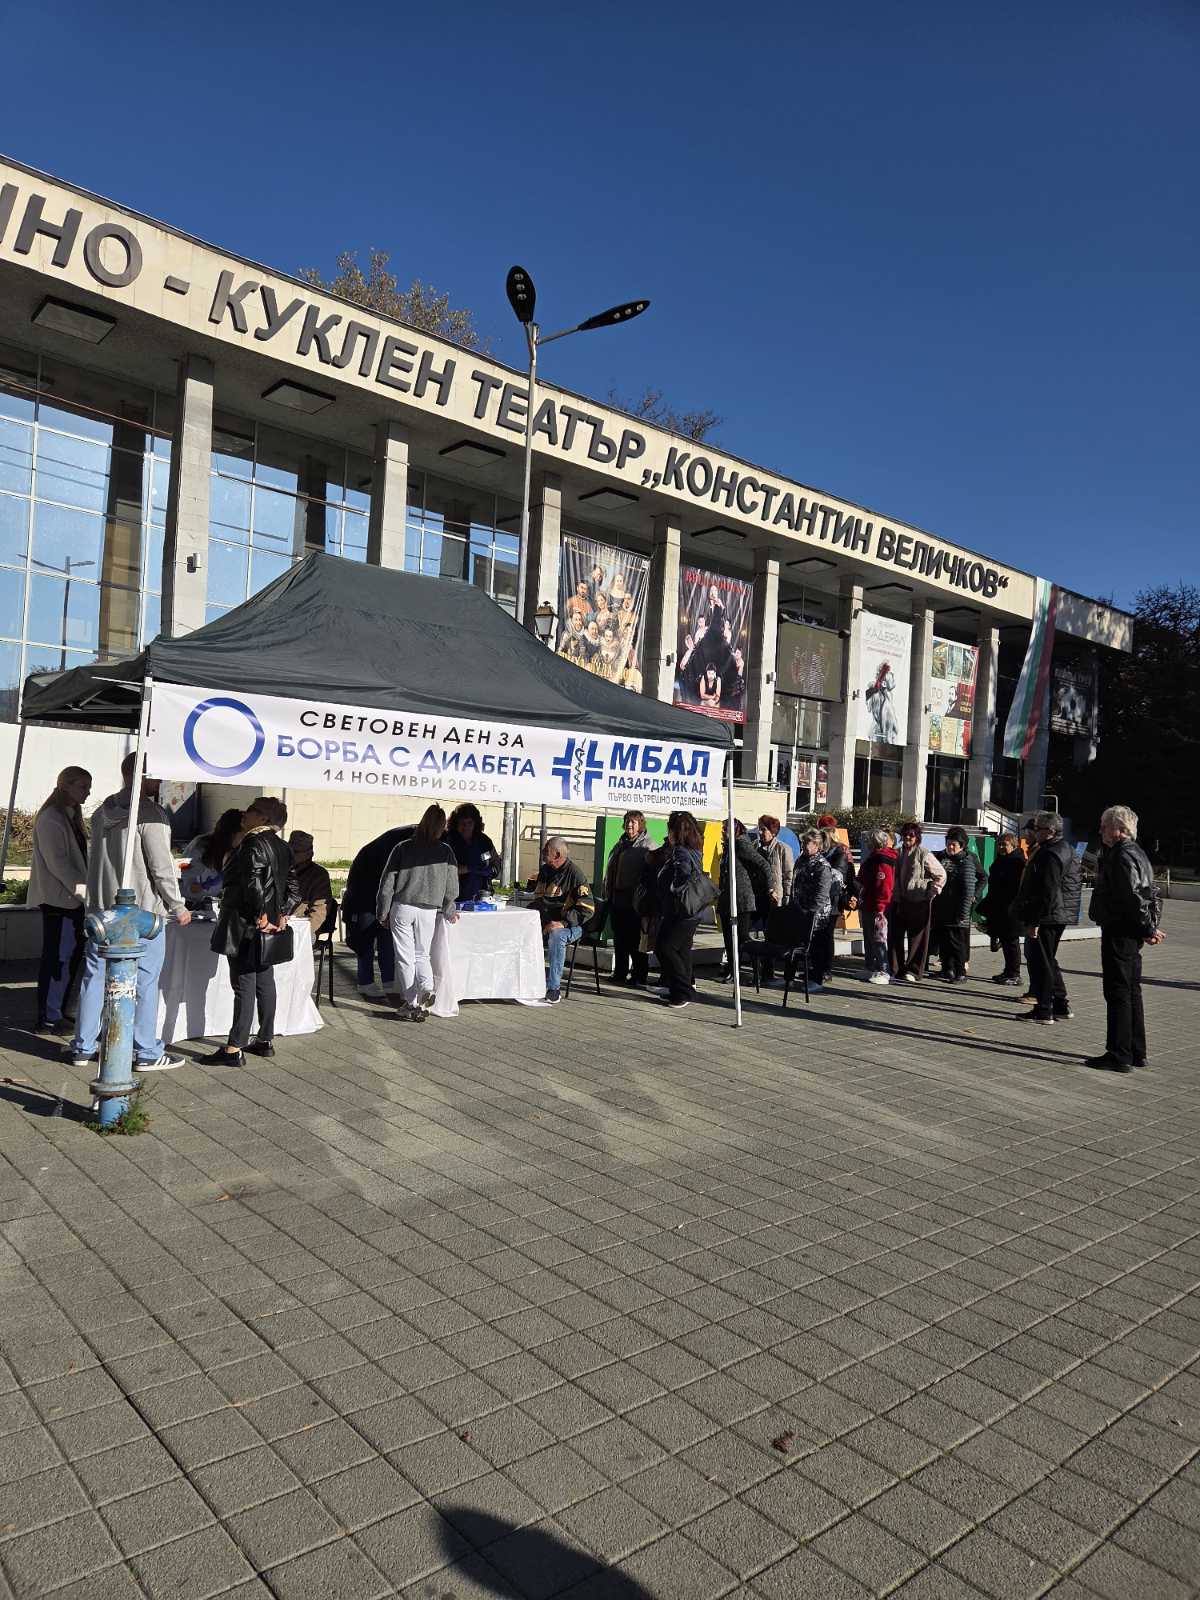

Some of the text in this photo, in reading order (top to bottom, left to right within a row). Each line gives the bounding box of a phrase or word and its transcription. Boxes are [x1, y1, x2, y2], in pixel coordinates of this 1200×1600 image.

[208, 270, 457, 405] КУКЛЕН
[471, 369, 646, 470] ТЕАТЪР
[299, 710, 525, 749] СВЕТОВЕН ДЕН ЗА
[276, 735, 536, 778] БОРБА С ДИАБЕТА
[609, 741, 711, 778] МБАЛ
[322, 768, 344, 783] 14
[351, 771, 443, 790] НОЕМВРИ
[448, 778, 488, 793] 2025
[608, 775, 708, 796] ПАЗАРДЖИК АД
[608, 792, 708, 807] ПЪРВО ВЪТРЕШНО ОТДЕЛЕНИЕ
